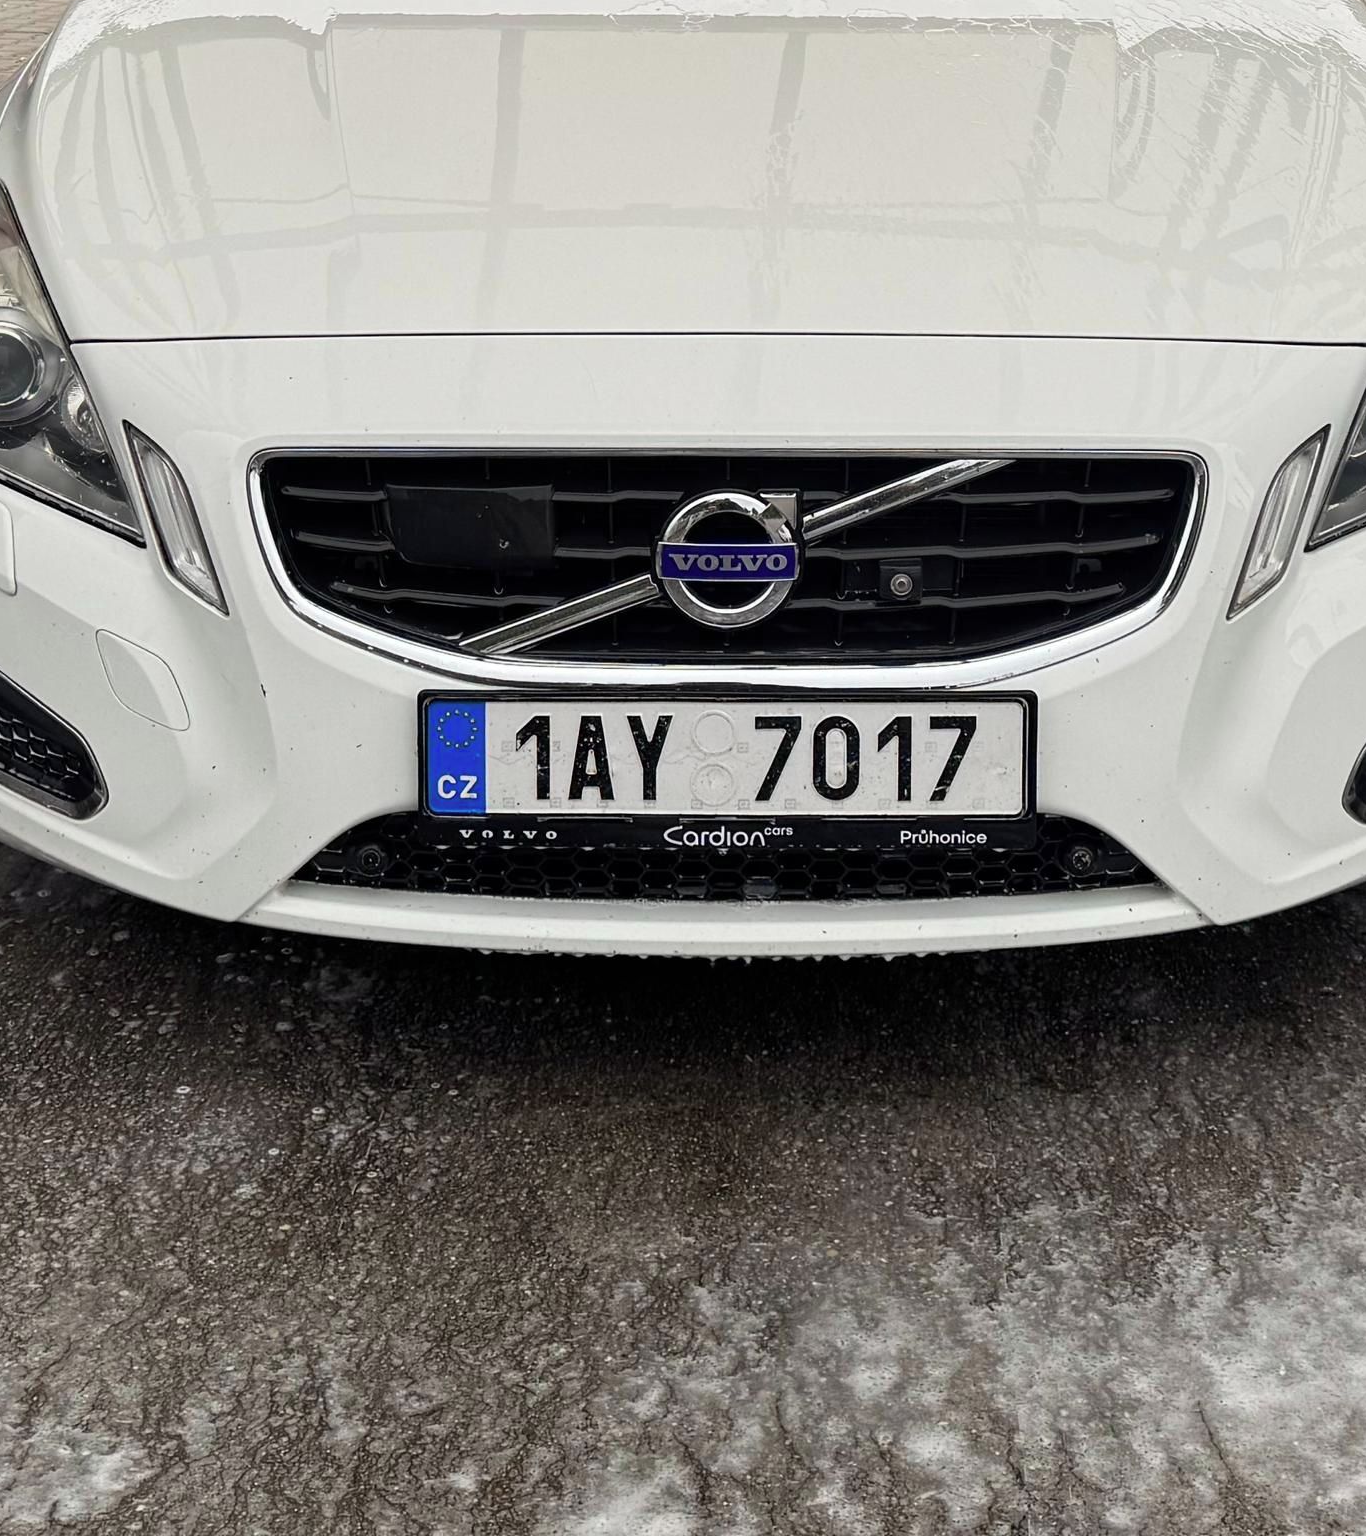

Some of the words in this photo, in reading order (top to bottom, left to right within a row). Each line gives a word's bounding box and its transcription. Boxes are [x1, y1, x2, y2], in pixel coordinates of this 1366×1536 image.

[668, 553, 788, 572] VOLVO
[515, 713, 674, 801] 1AY
[754, 715, 977, 802] 7017
[437, 774, 478, 800] CZ
[459, 829, 558, 840] VOLVO
[663, 825, 766, 847] Cardion
[764, 826, 793, 836] cars
[900, 829, 987, 844] Průhonice
